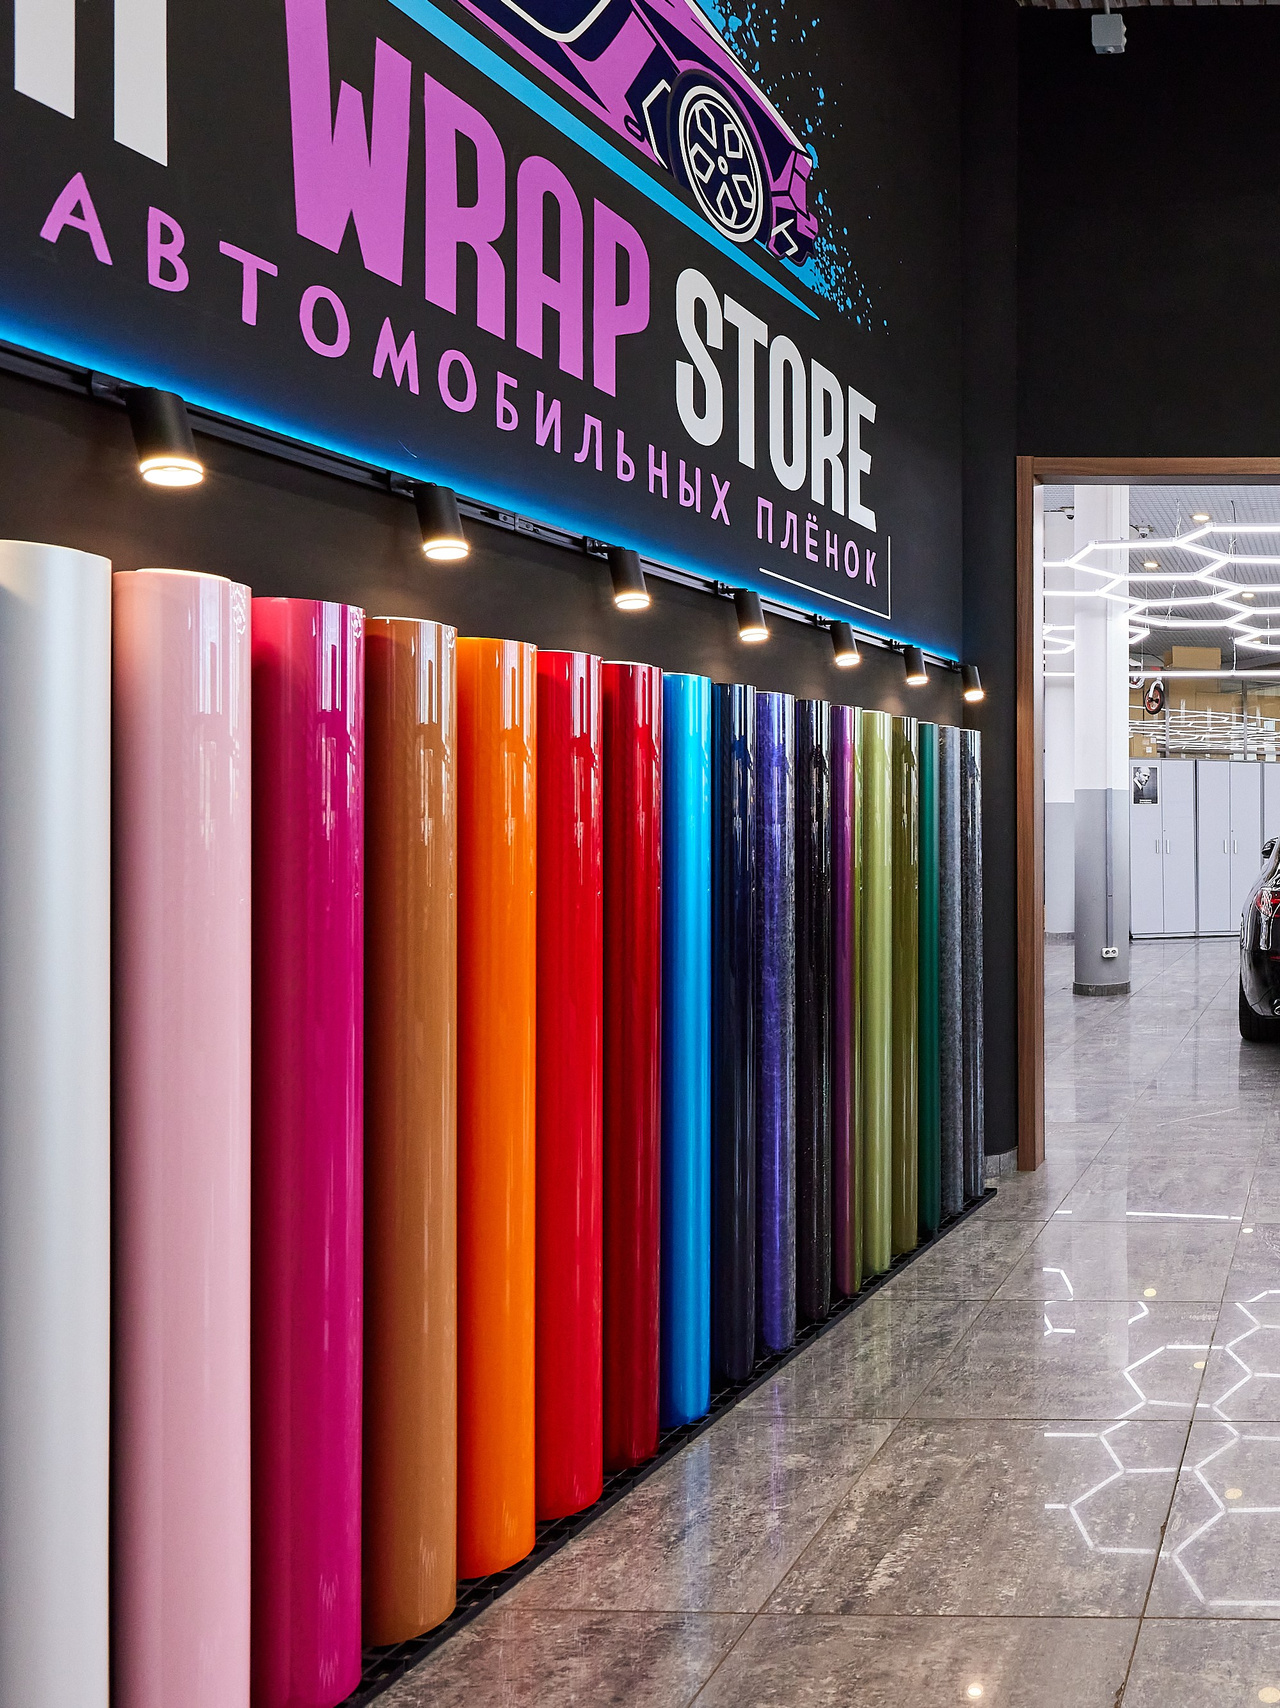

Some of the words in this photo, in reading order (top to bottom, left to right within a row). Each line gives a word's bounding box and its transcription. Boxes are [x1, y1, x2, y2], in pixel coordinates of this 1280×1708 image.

[40, 172, 732, 526] АВТОМОБИЛЬНЫХ
[757, 496, 878, 588] ПЛЁНОК
[285, 0, 651, 397] WRAP
[675, 268, 877, 532] STORE
